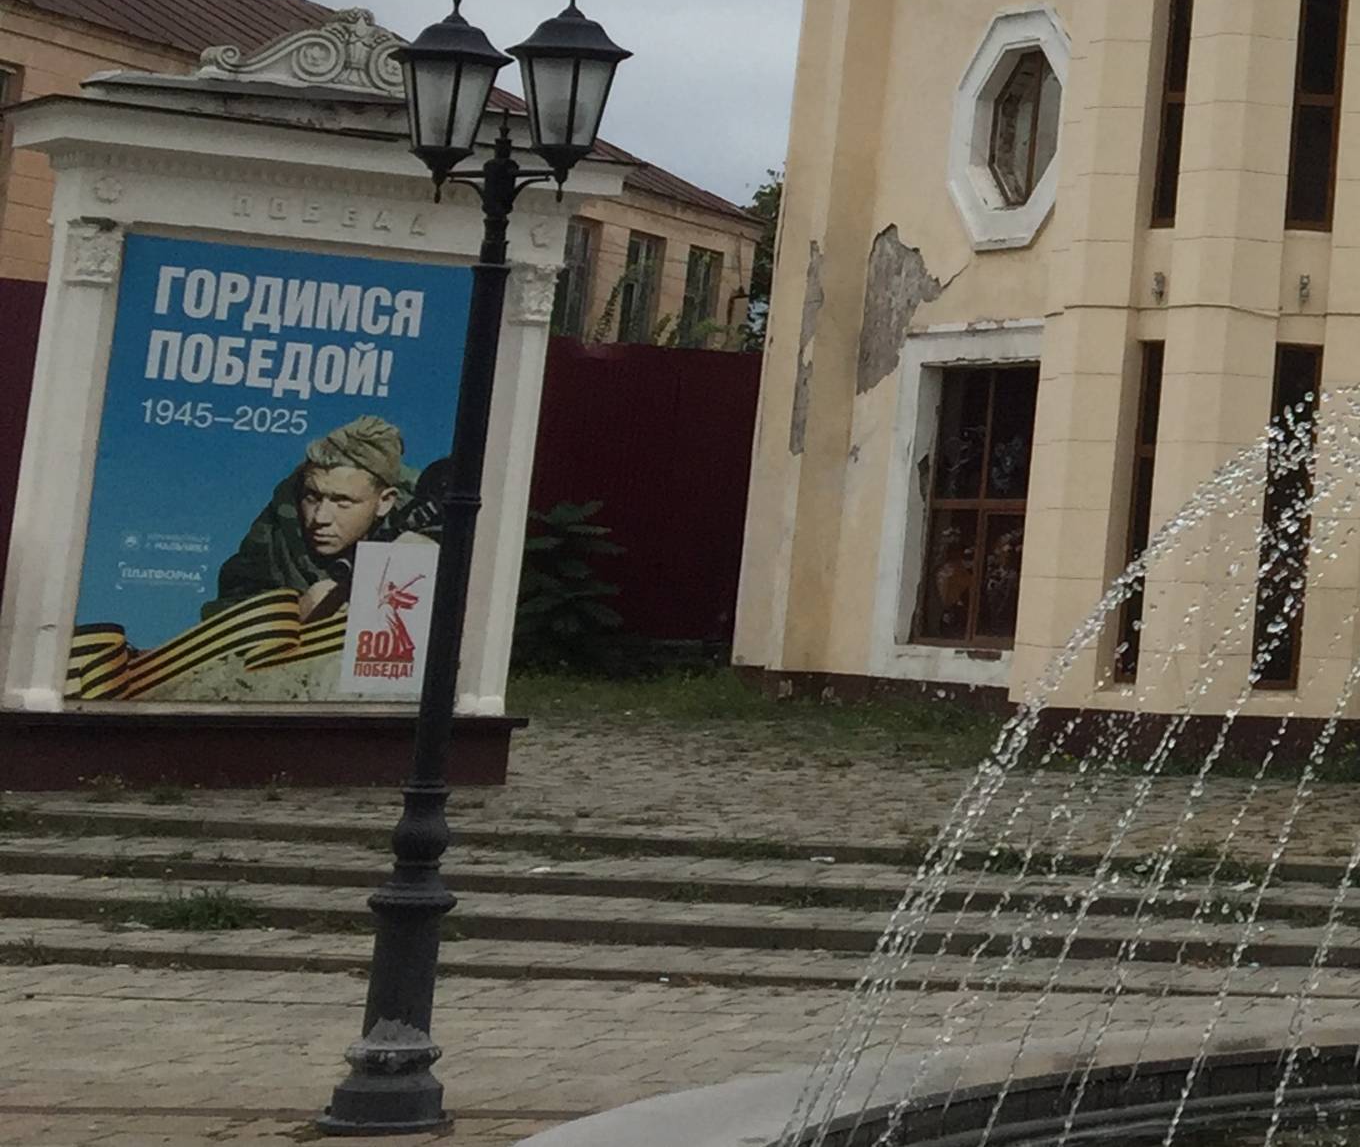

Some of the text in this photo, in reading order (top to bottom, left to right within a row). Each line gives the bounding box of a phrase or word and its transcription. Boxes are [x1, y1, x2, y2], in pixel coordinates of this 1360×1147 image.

[154, 265, 424, 338] ГОРДИМСЯ
[144, 329, 394, 400] ПОБЕДОЙ!
[353, 662, 414, 679] ПОБЕДА!
